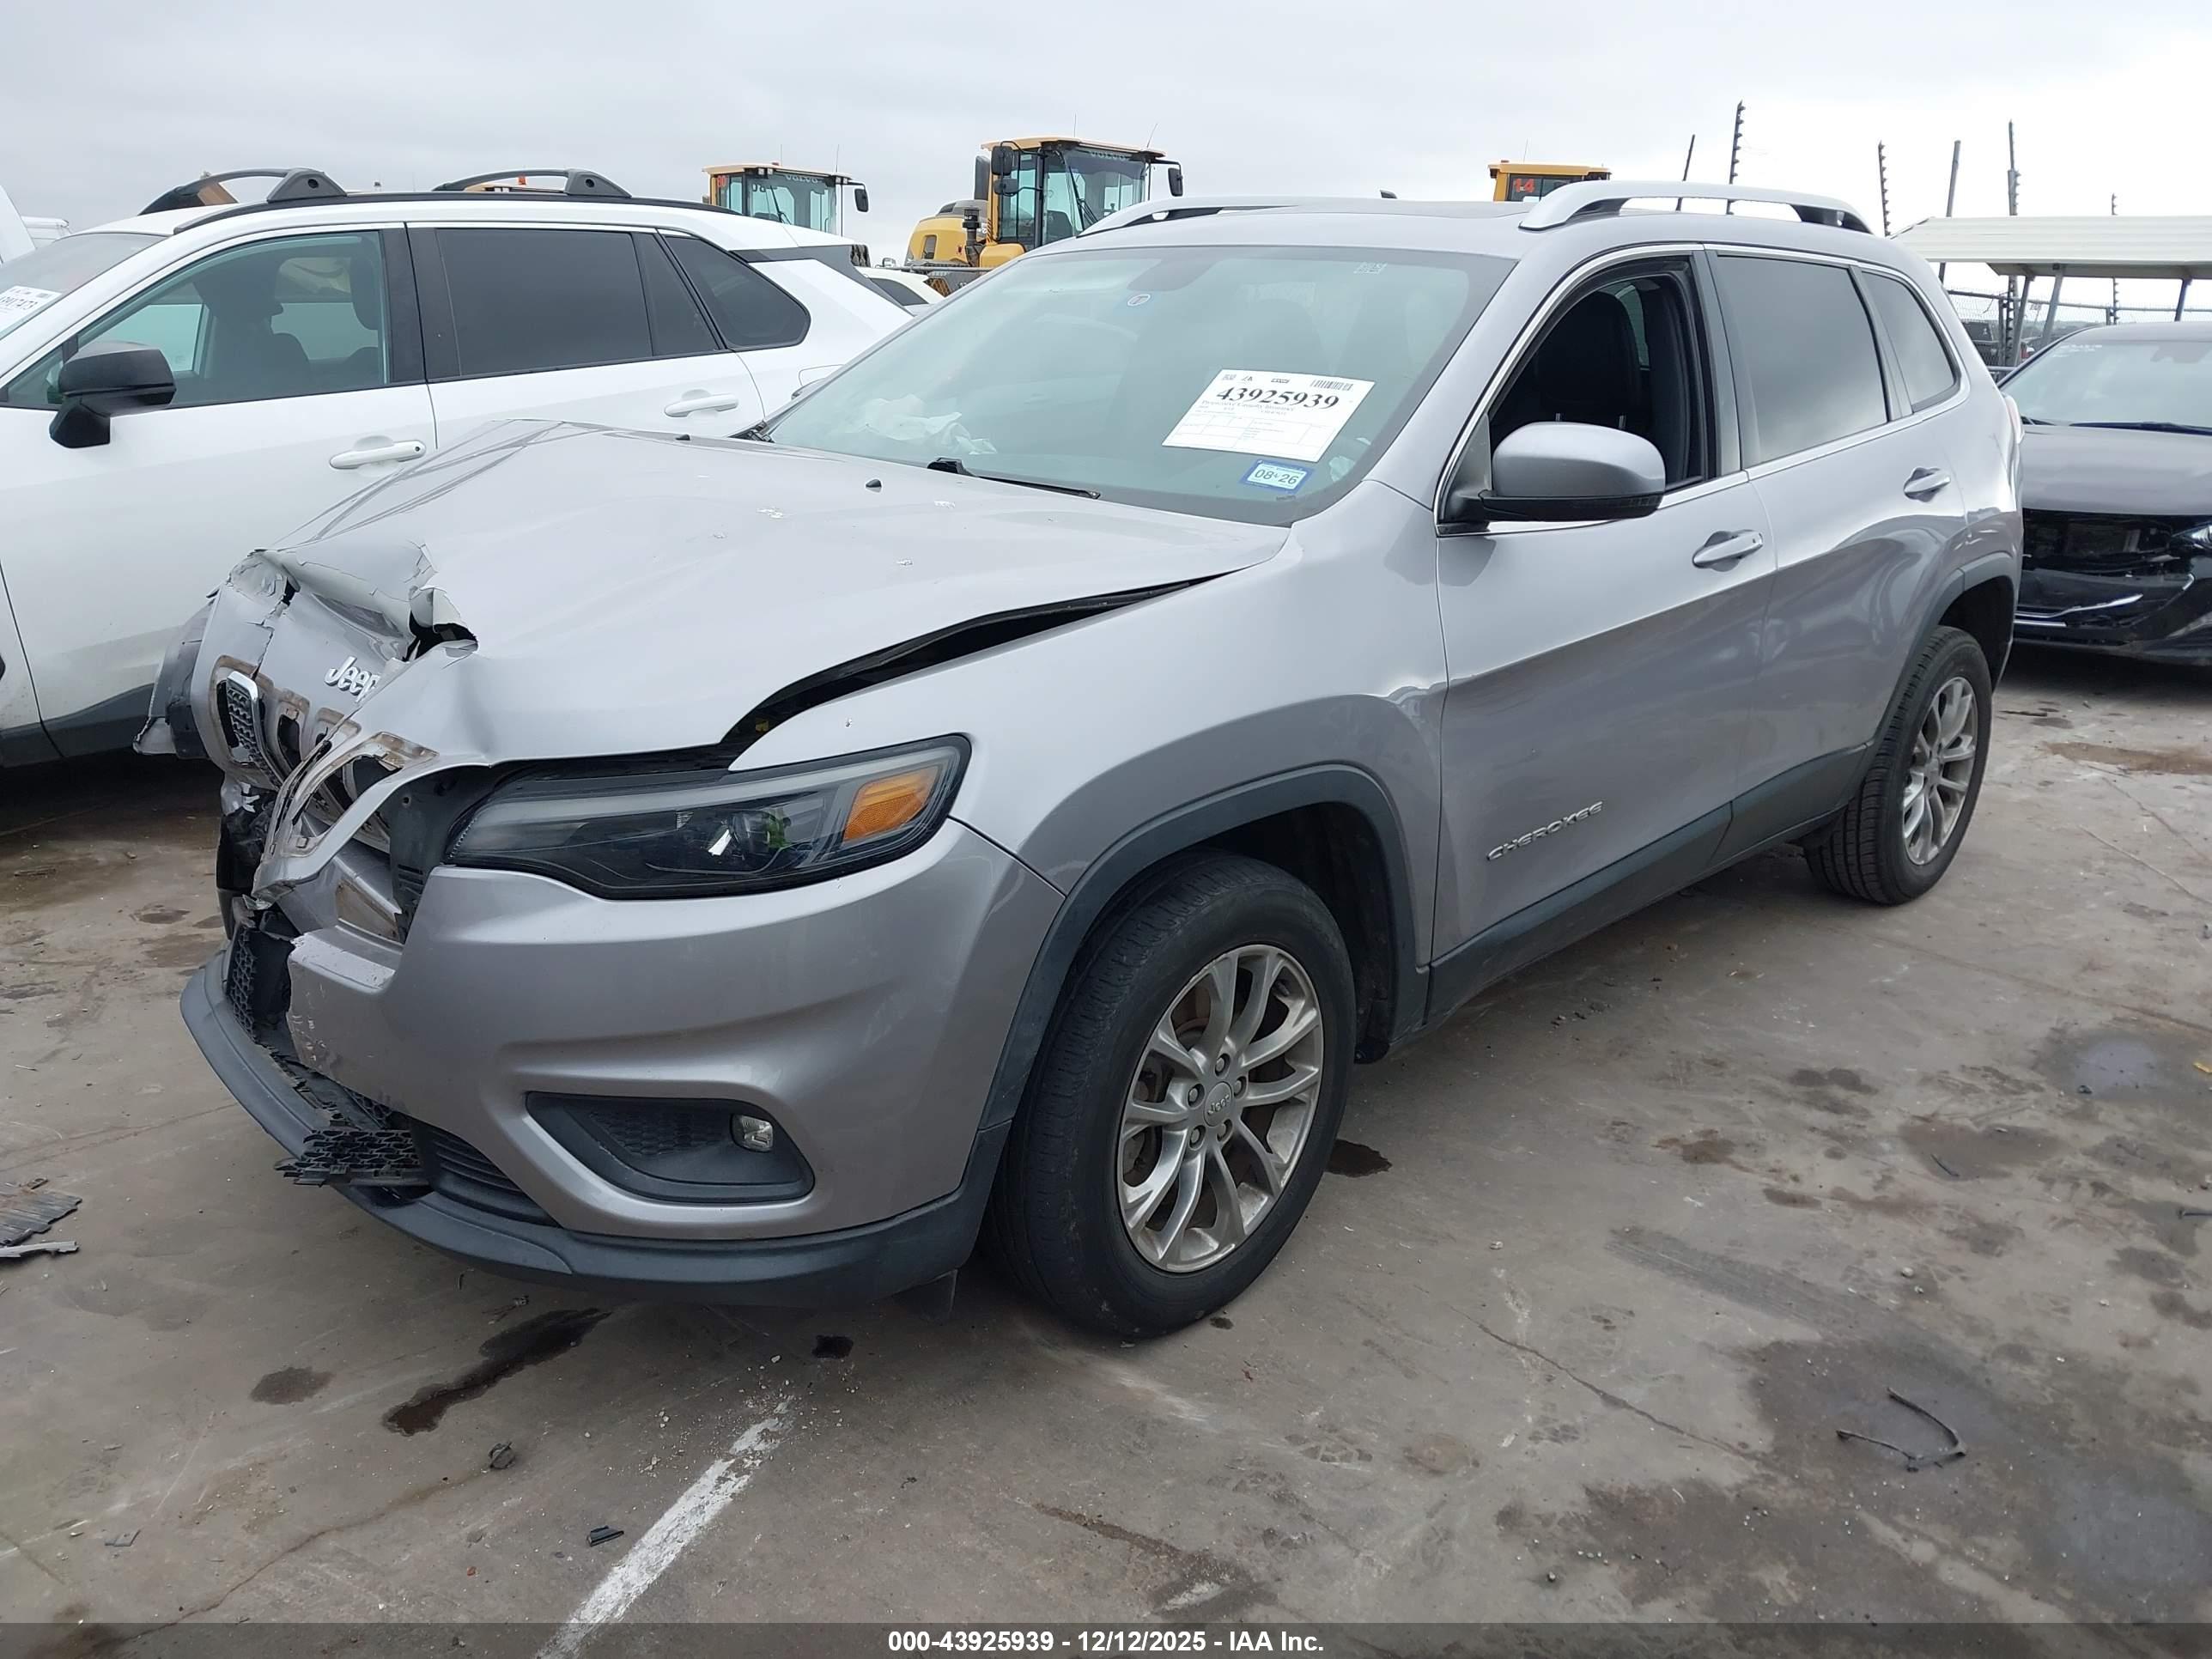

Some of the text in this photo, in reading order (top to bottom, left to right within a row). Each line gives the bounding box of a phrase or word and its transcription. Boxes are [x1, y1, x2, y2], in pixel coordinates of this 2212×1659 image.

[1216, 386, 1340, 410] 43925939
[1255, 469, 1274, 480] 08
[1278, 473, 1299, 484] 26
[324, 655, 380, 703] Jeep
[1486, 800, 1603, 860] CHEROKEE
